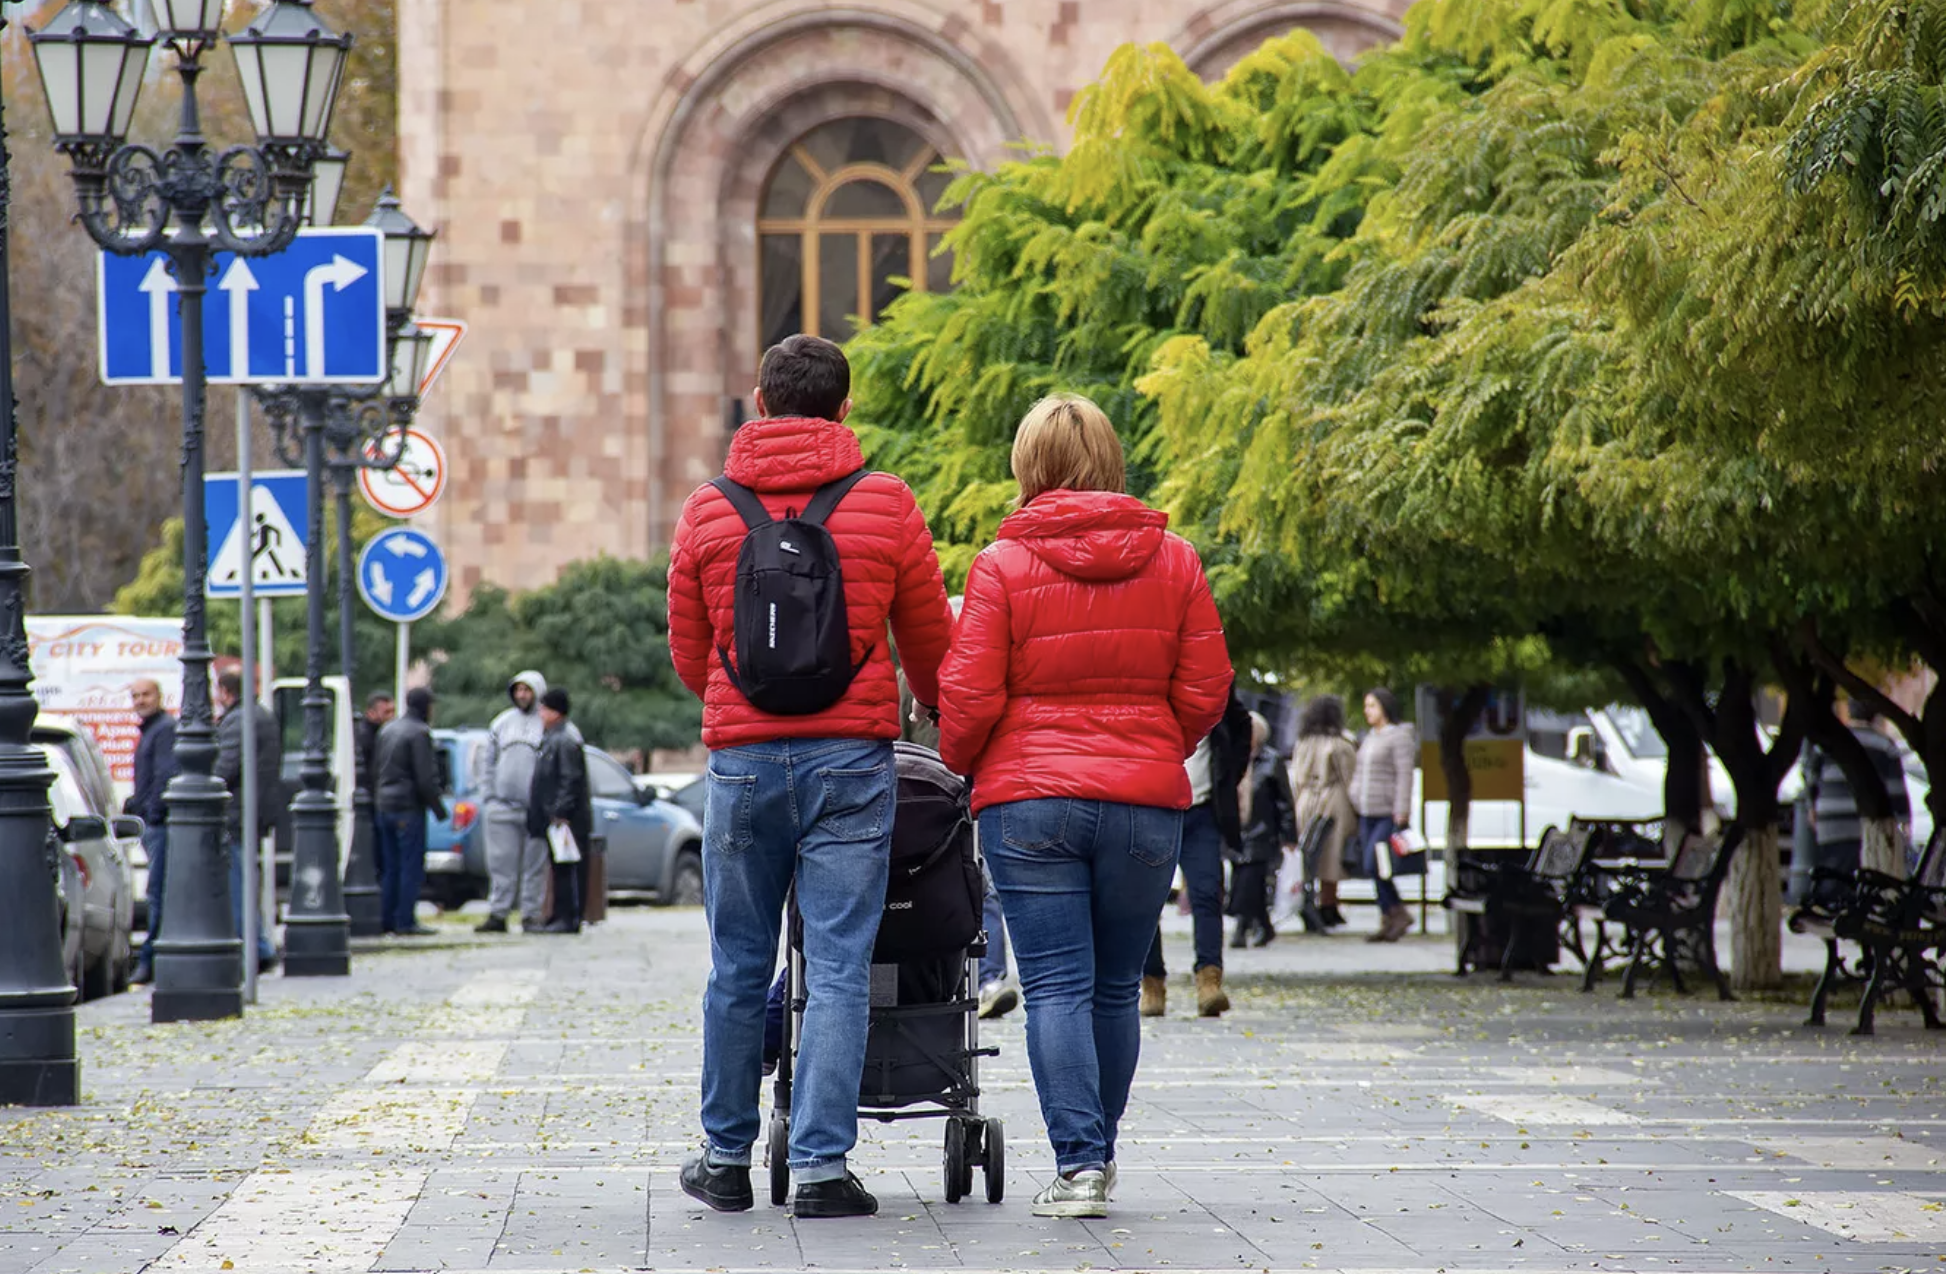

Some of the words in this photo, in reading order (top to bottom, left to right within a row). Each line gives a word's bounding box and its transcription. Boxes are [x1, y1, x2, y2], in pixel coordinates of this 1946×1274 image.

[49, 641, 105, 657] CITY
[118, 641, 181, 657] TOUR
[889, 900, 913, 910] cool
